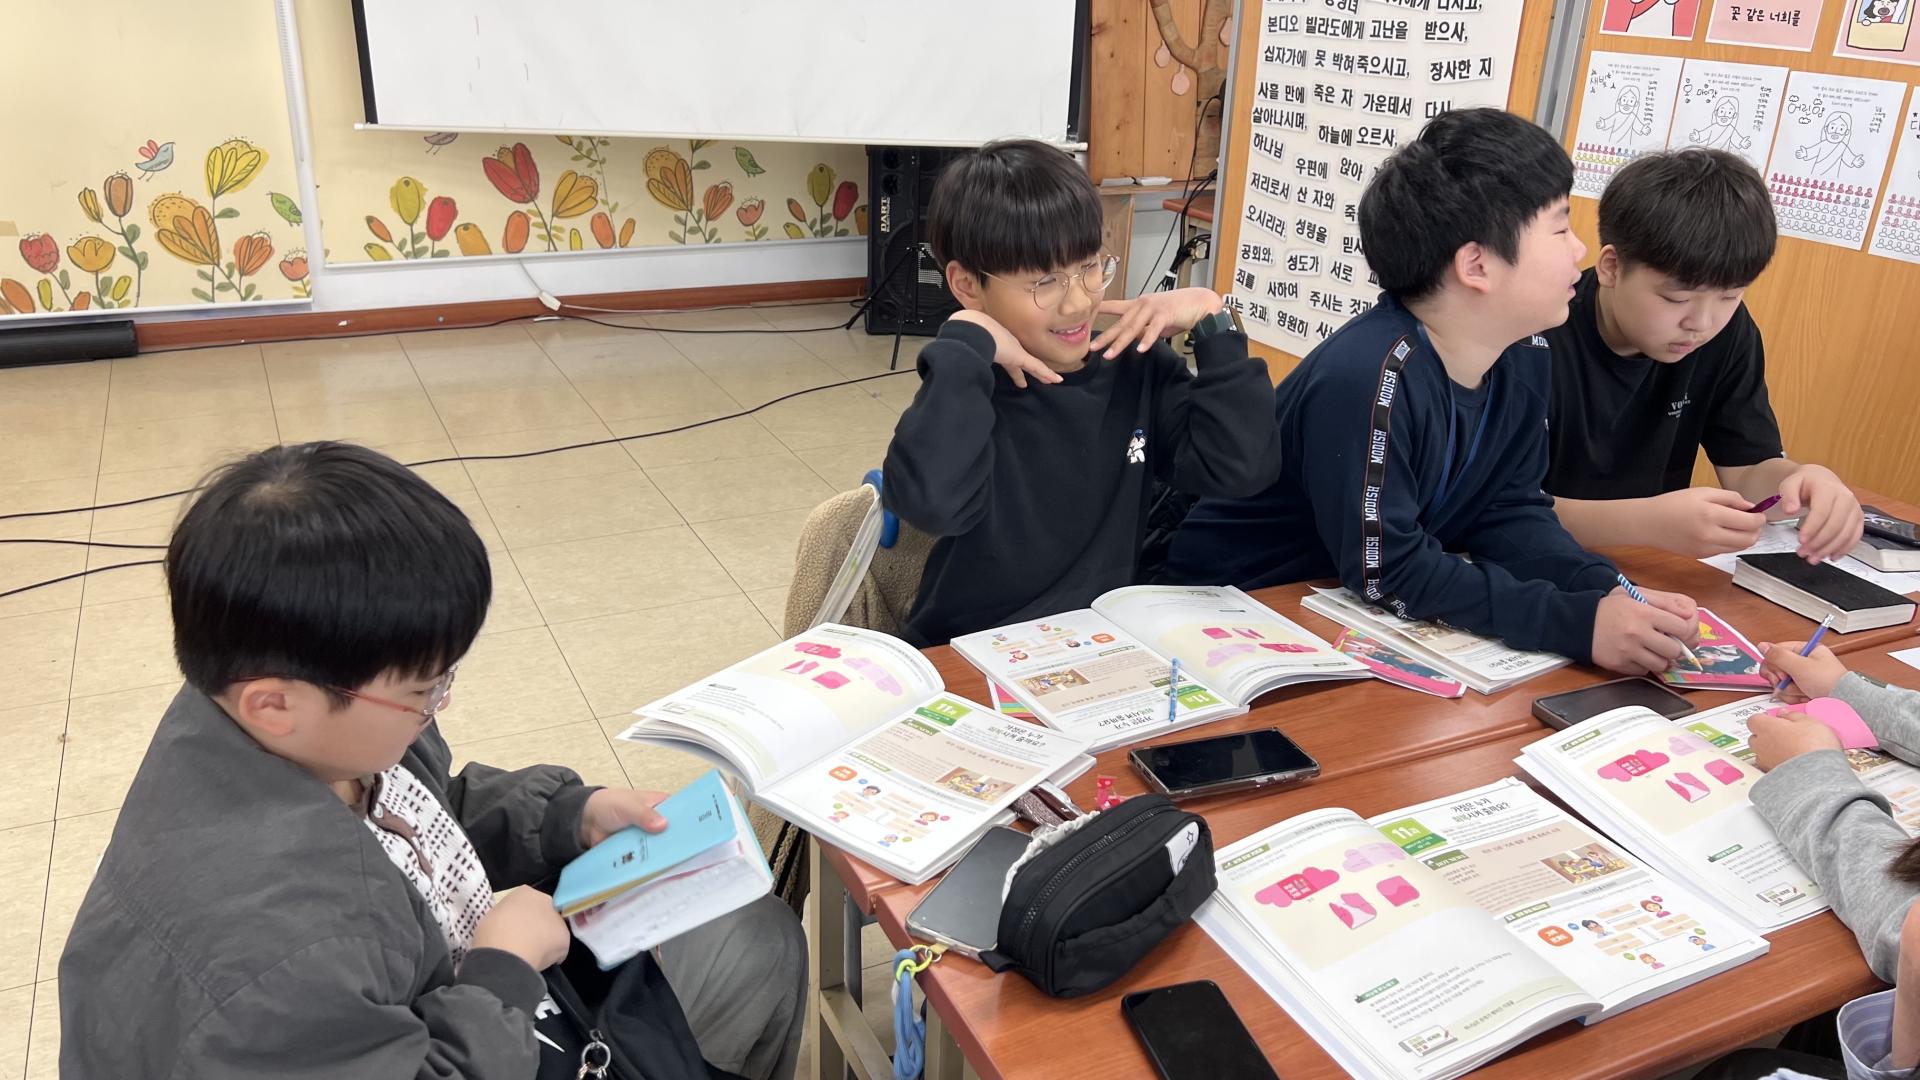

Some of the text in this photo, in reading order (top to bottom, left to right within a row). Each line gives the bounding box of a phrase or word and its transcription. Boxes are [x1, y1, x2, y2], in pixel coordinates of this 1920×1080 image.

[1267, 15, 1468, 43] 본디오 빌라도에게 고난을 받으사,
[1730, 6, 1801, 27] 꽃 같은 너희를
[1264, 46, 1492, 81] 십자가에 못 박혀 죽으시고, 장사한 지
[1258, 81, 1279, 100] 사흘
[1285, 85, 1305, 103] 만에
[1313, 84, 1336, 103] 죽은
[1341, 88, 1353, 107] 자
[1363, 93, 1412, 117] 가운데서
[1252, 107, 1307, 130] 살아나시며,
[1253, 134, 1284, 159] 하나님
[1318, 125, 1398, 148] 하늘에 오르사,
[1295, 157, 1363, 182] 우편에 앉아
[1250, 172, 1290, 200] 저리로서
[1297, 187, 1308, 203] 산
[1312, 189, 1335, 210] 자와
[1295, 218, 1328, 244] 성령을
[1241, 244, 1273, 264] 공회와,
[1287, 255, 1320, 272] 성도가
[1330, 261, 1353, 283] 서로
[1236, 269, 1256, 290] 죄를
[1267, 281, 1298, 299] 사하여
[1309, 291, 1343, 313] 주시는
[1277, 310, 1309, 338] 영원히
[1377, 369, 1397, 408] MODISH
[1370, 429, 1387, 464] MODISH
[1365, 486, 1381, 521] MODISH
[1365, 536, 1380, 568] MODISH
[1450, 797, 1493, 813] 가정은 누가
[1482, 801, 1510, 816] 줄까요?
[1391, 826, 1422, 839] 11과
